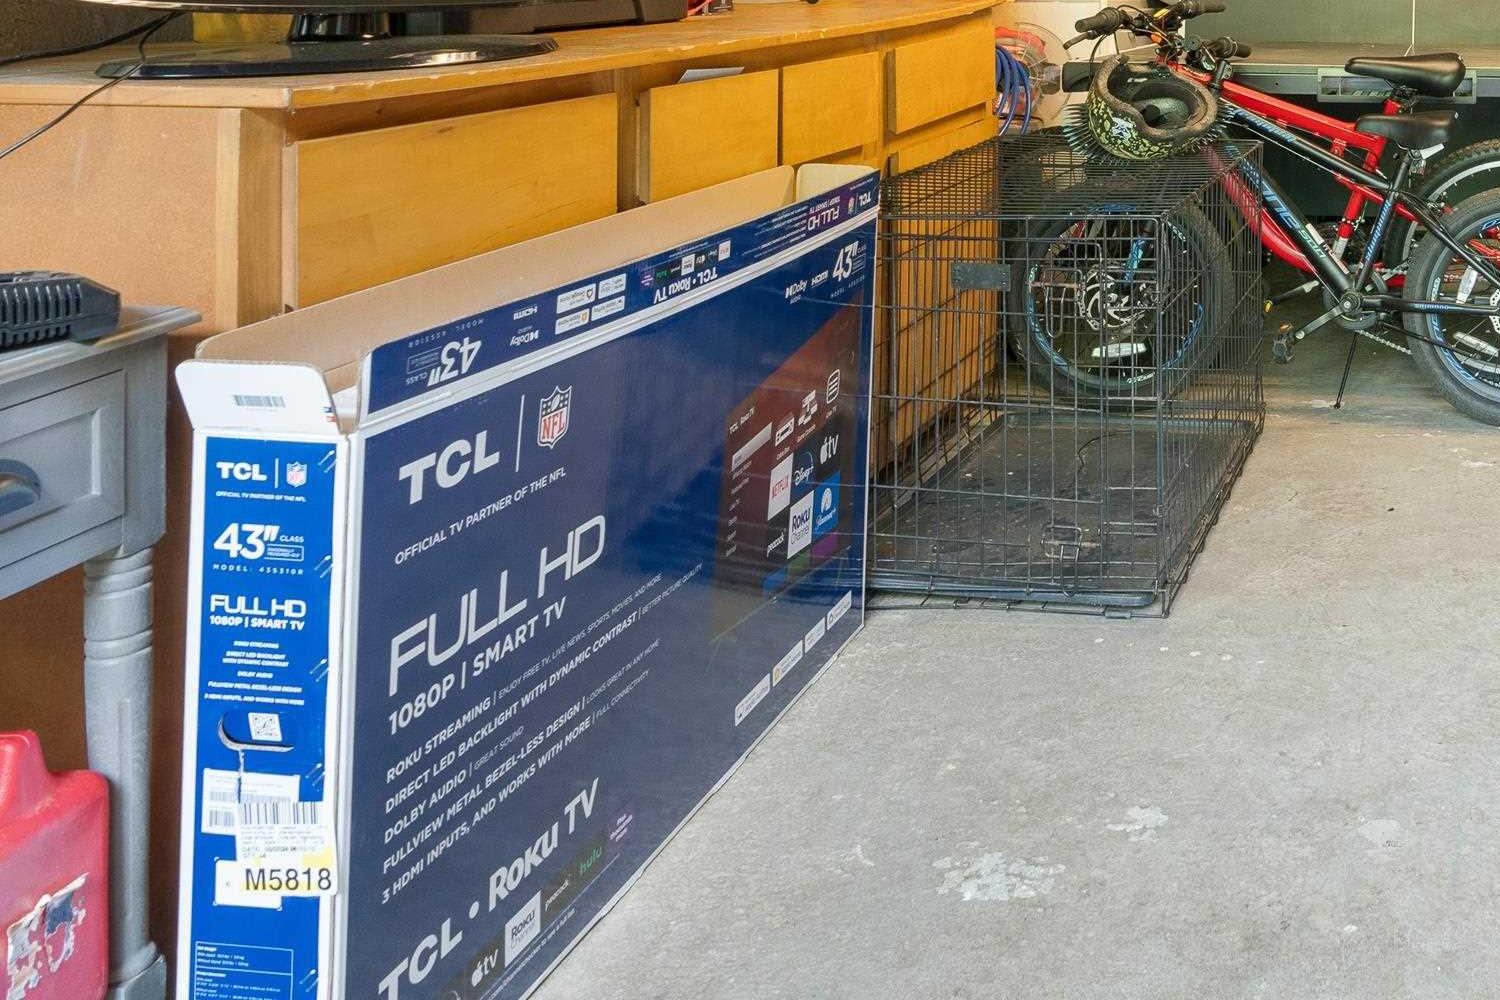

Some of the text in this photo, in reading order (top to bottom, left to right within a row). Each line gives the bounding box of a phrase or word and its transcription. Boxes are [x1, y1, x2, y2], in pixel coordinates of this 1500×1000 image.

[697, 267, 718, 284] TCL
[541, 410, 566, 441] NFL
[216, 461, 267, 481] TCL
[399, 430, 500, 505] TCL
[213, 522, 280, 560] 43"
[279, 535, 304, 543] CLASS
[394, 466, 567, 565] OFFICIAL TV PARTNER OF THE NFL
[209, 615, 305, 630] 1080P SMART TV
[210, 594, 307, 618] FULL HD
[389, 515, 606, 697] FULL HD
[389, 595, 567, 736] 1080P SMART TV
[385, 769, 432, 814] DIRECT
[433, 750, 456, 776] LED
[458, 701, 520, 757] BACKLIGHT
[520, 679, 548, 708] WITH
[549, 646, 591, 687] DYNAMIC
[592, 608, 638, 653] CONTRAST
[386, 751, 422, 784] ROKU
[424, 697, 491, 755] STREAMING
[499, 678, 522, 700] ENJOY
[381, 887, 391, 905] 3
[392, 858, 424, 896] HDMI
[426, 821, 471, 866] INPUTS,
[472, 797, 496, 827] AND
[499, 764, 537, 802] WORKS
[537, 740, 563, 769] WITH
[564, 715, 591, 746] MORE
[382, 813, 445, 875] FULLVIEW
[447, 783, 483, 821] METAL
[485, 731, 544, 788] BEZEL-LESS
[546, 701, 581, 739] DESIGN
[384, 801, 427, 844] DOLBY
[429, 769, 467, 808] AUDIO
[245, 867, 332, 891] M5818
[378, 917, 463, 1000] TCL
[488, 821, 559, 913] ROKU
[564, 776, 599, 835] TV
